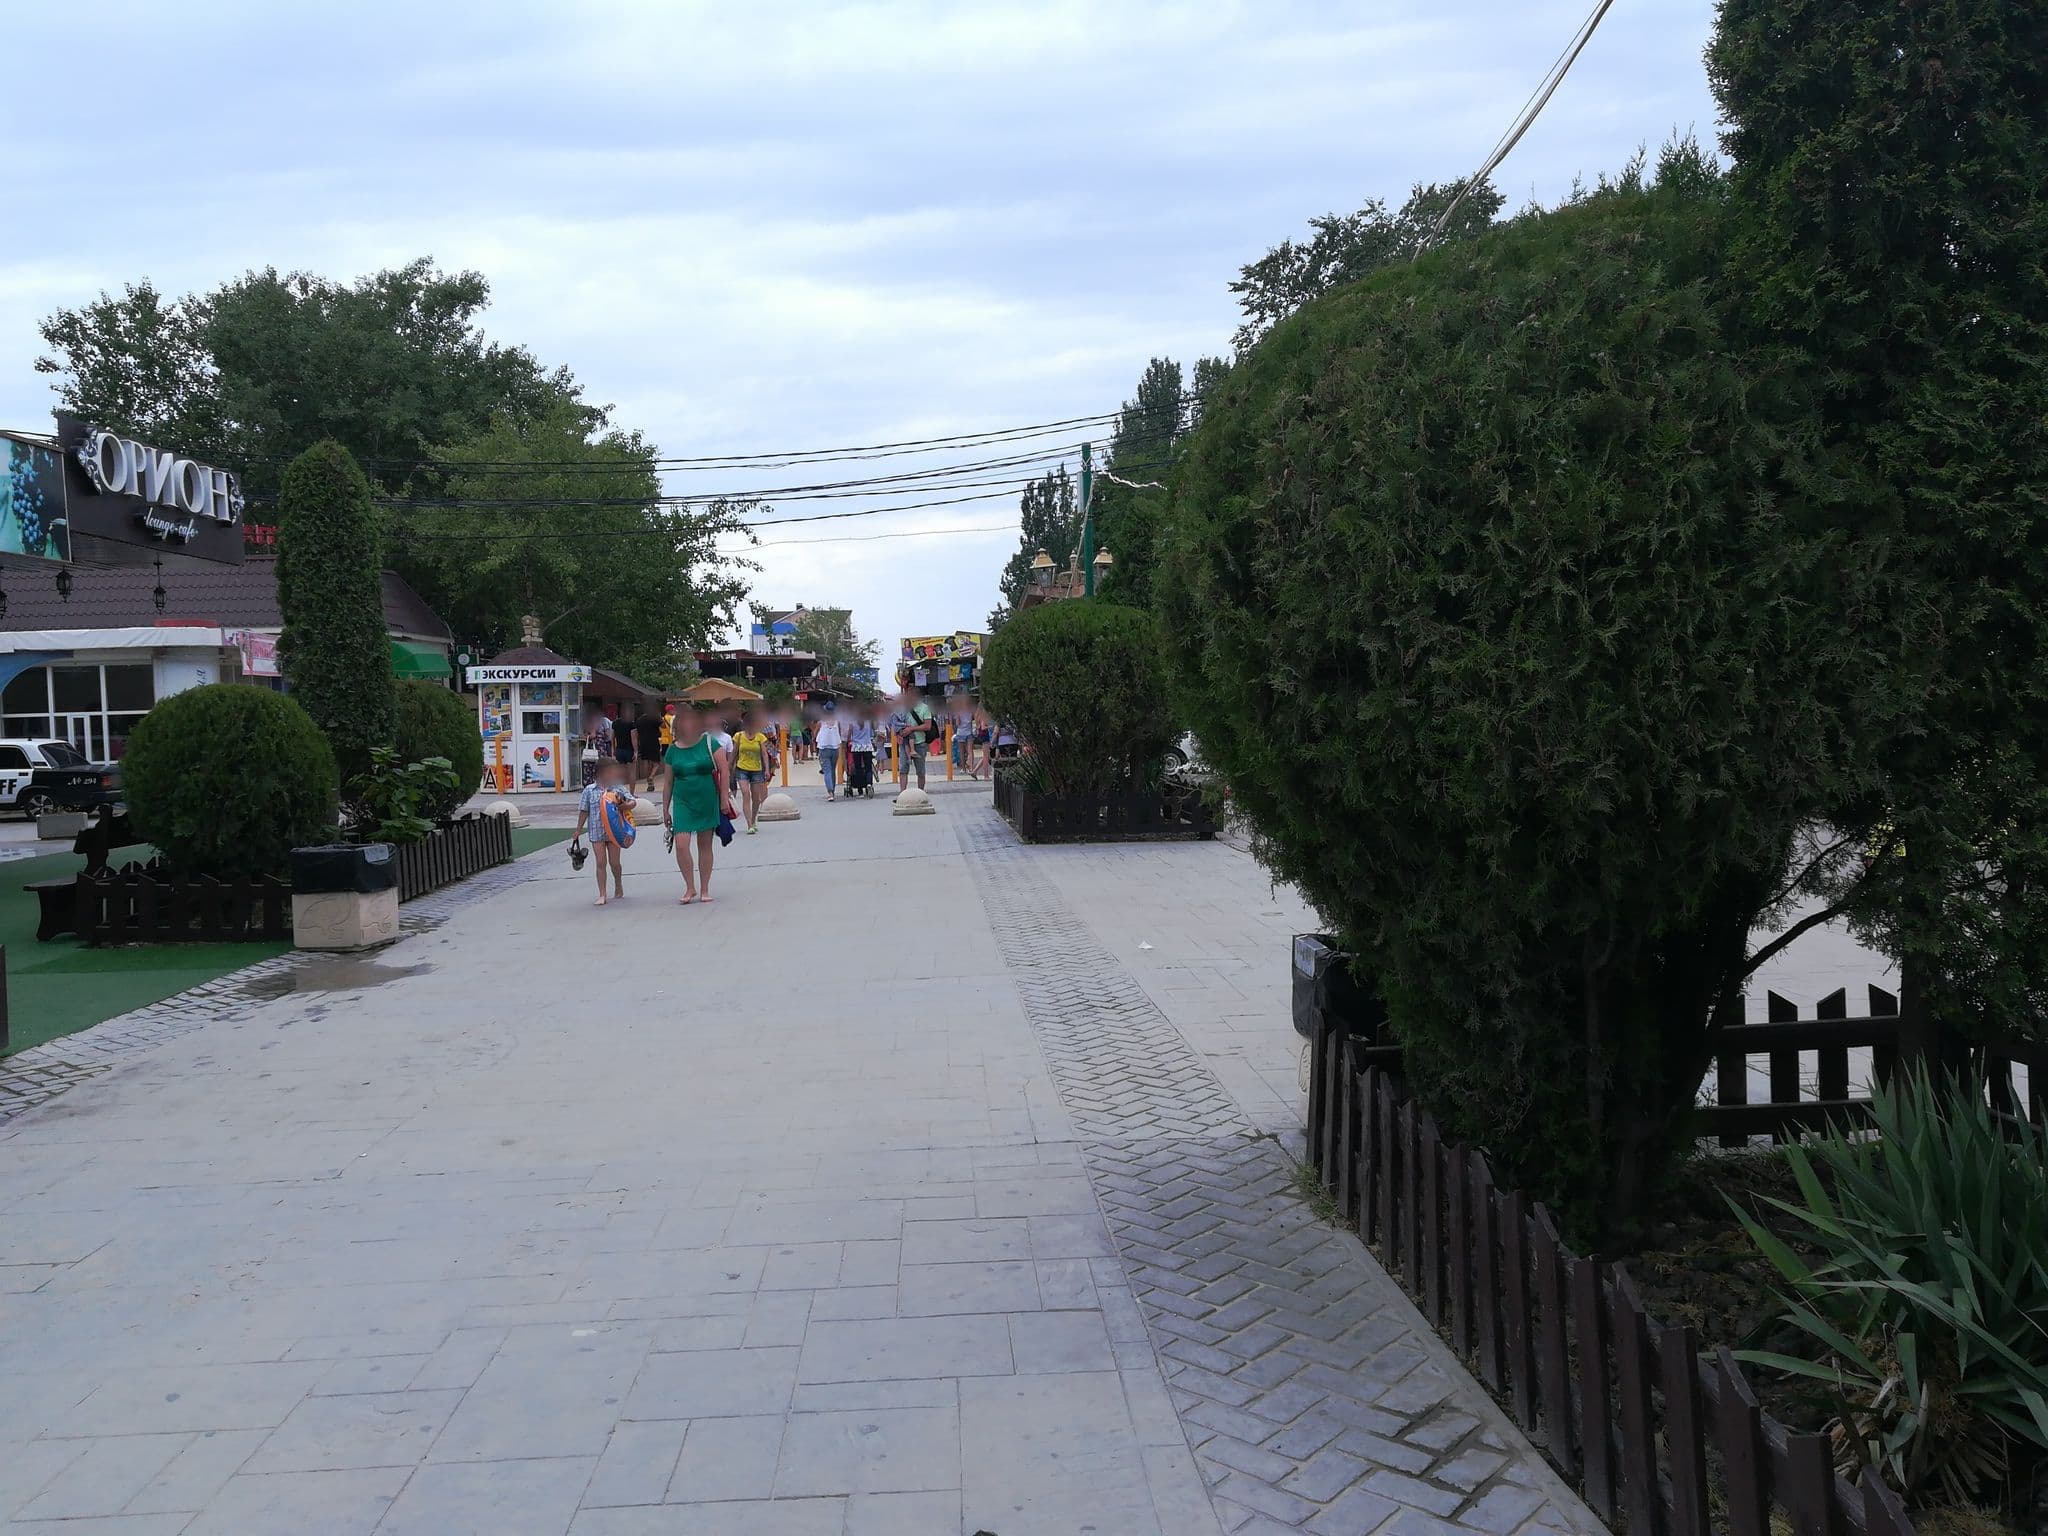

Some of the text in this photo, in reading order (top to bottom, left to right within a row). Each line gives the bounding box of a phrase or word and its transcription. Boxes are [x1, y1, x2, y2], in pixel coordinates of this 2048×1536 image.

[96, 432, 231, 522] ОРИОН
[756, 647, 795, 656] ОЛМП
[482, 668, 556, 680] ЭКСКУРСИИ
